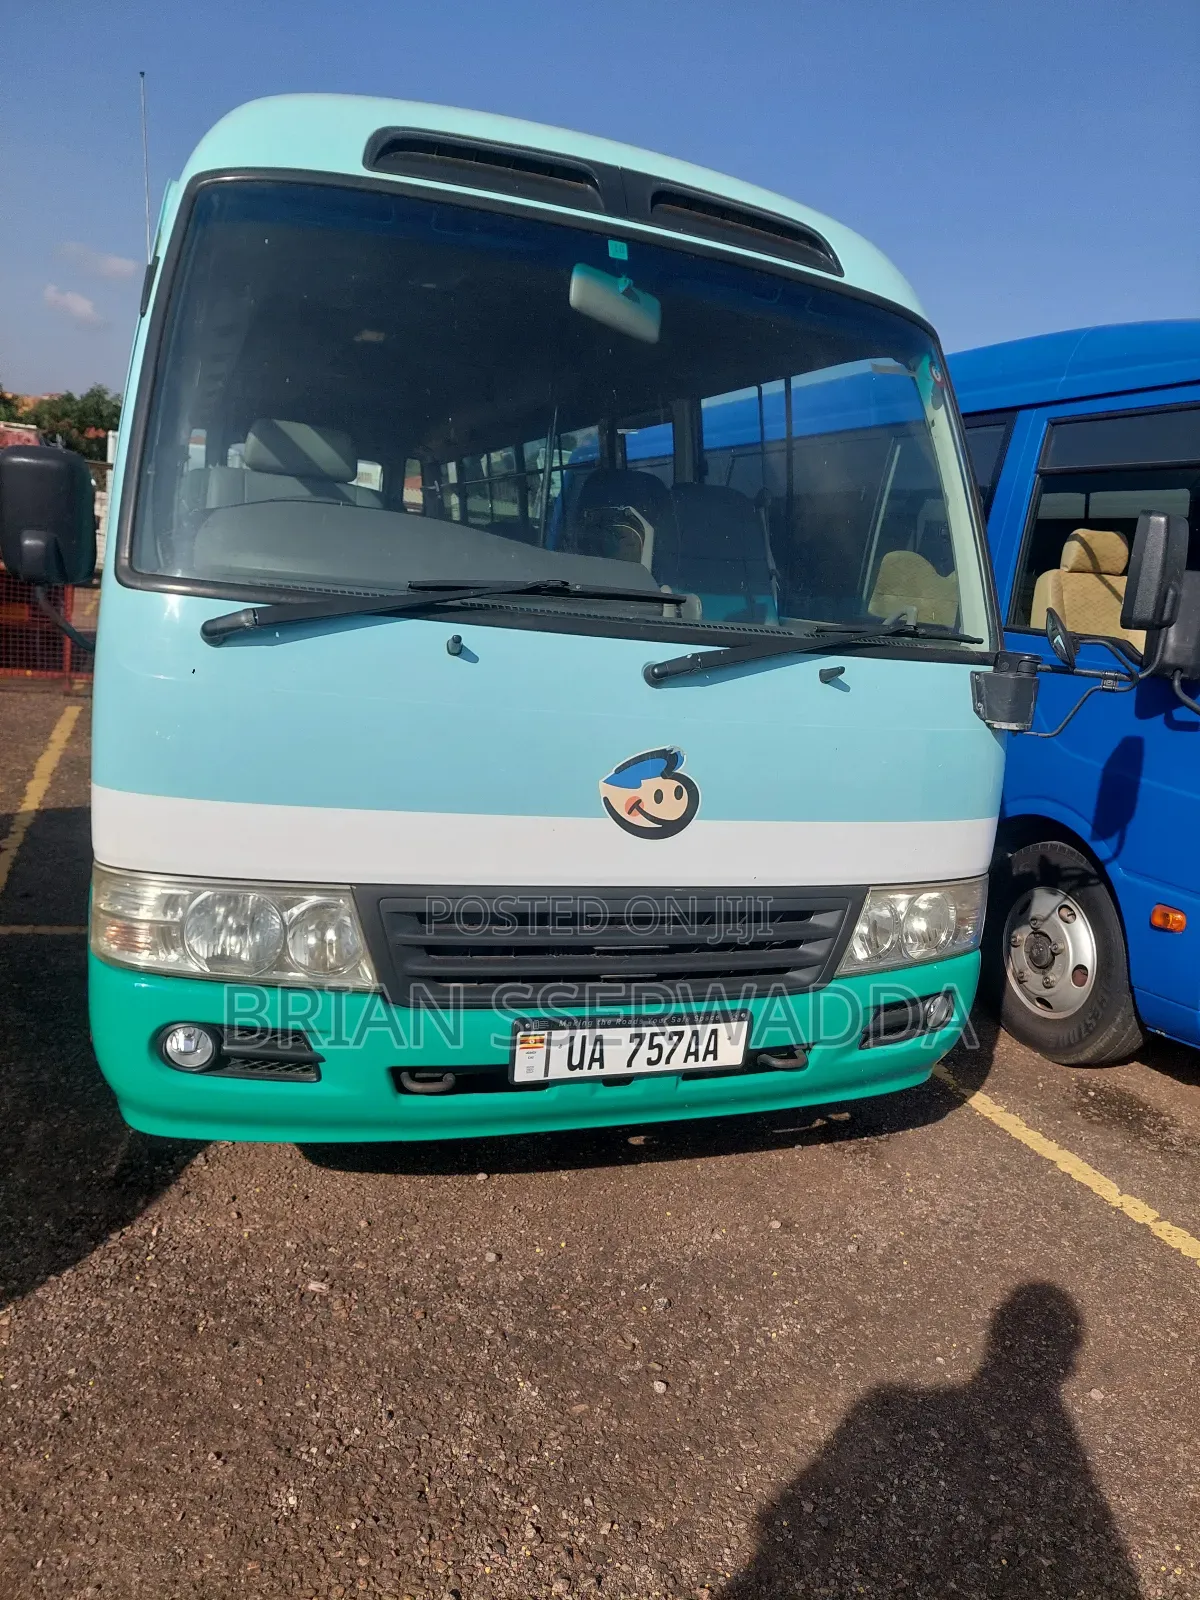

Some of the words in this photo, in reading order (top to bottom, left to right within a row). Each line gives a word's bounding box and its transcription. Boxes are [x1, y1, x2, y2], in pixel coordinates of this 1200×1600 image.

[597, 1018, 612, 1026] the
[671, 1015, 691, 1023] Safe
[566, 1033, 605, 1072] UA
[625, 1027, 719, 1069] 757AA
